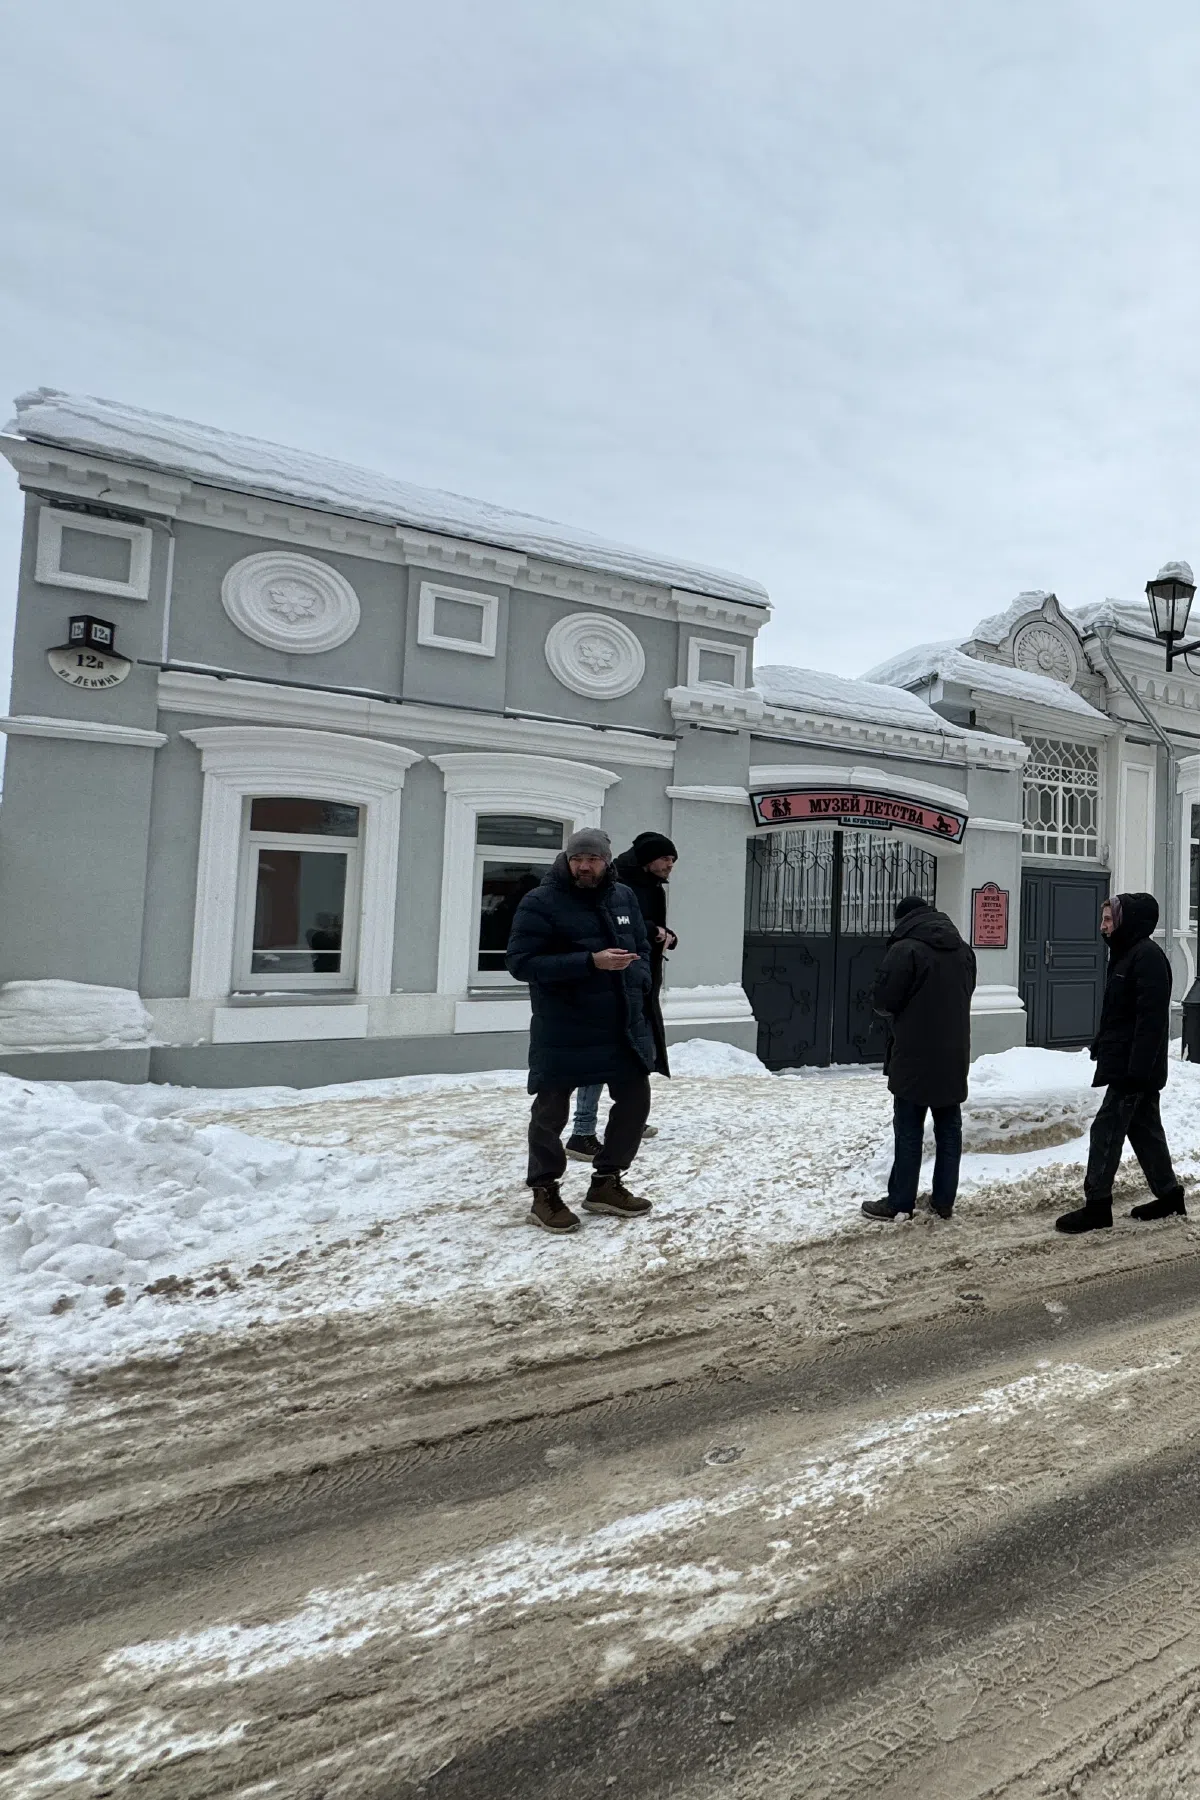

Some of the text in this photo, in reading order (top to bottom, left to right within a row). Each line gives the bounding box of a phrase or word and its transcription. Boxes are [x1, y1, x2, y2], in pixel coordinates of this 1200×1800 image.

[73, 674, 120, 687] ЛЕНИНА
[809, 795, 924, 825] МУЗЕЙ ДЕТСТВА
